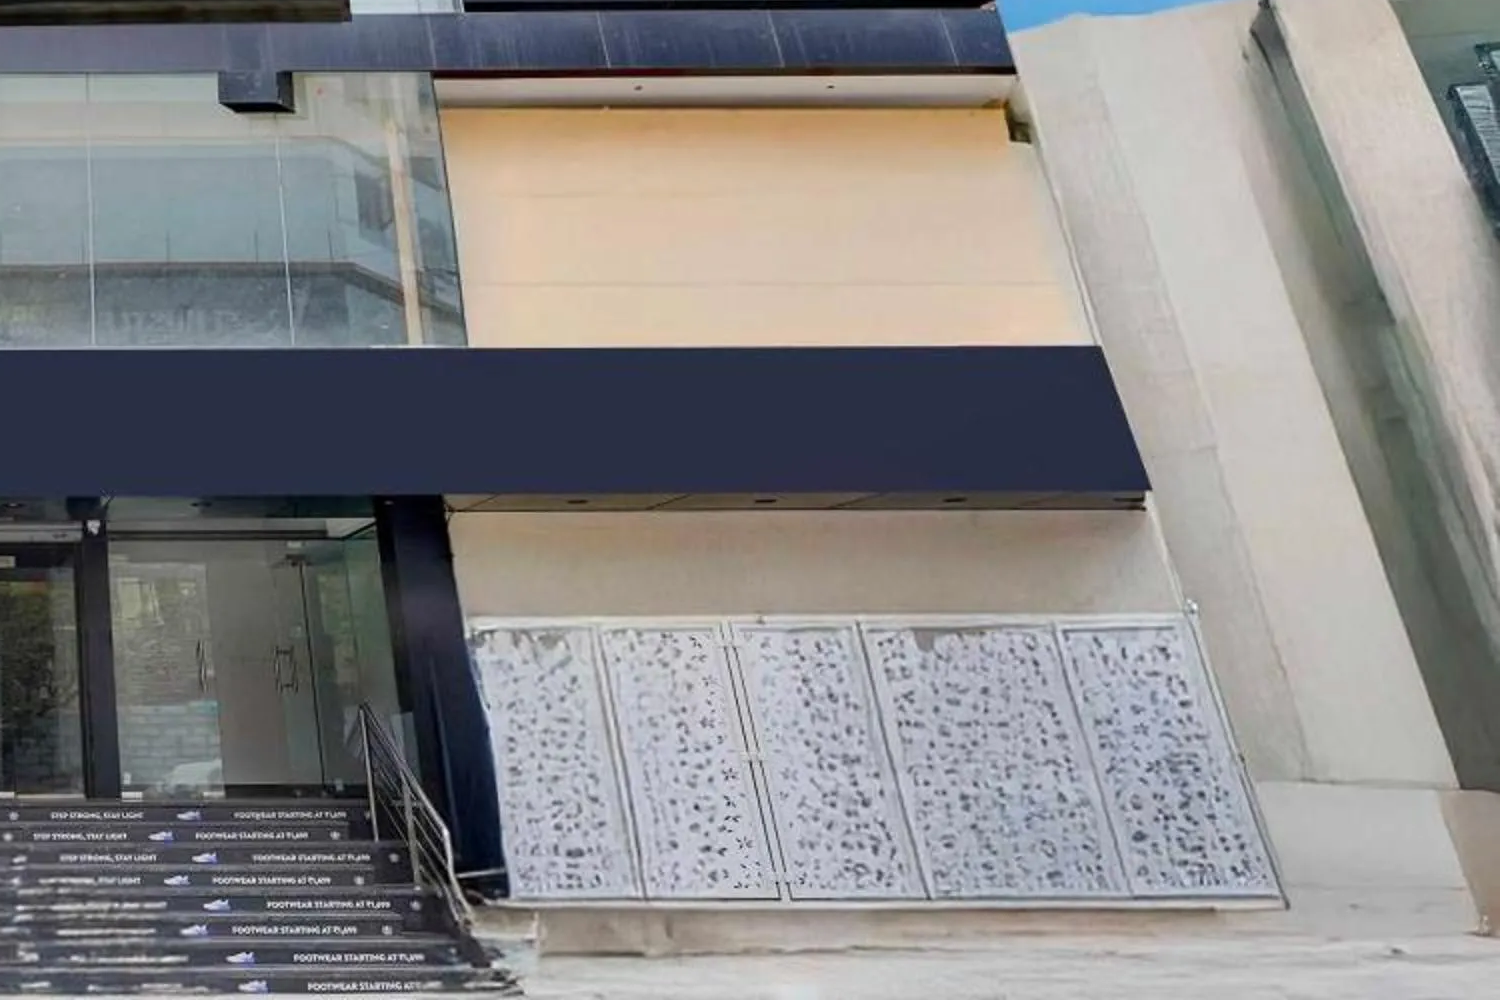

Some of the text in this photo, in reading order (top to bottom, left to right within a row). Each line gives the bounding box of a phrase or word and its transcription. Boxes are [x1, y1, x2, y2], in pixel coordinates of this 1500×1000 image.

[234, 811, 276, 820] FOOTWEAR
[278, 811, 313, 820] STARTING
[195, 832, 237, 841] FOOTWEAR
[239, 832, 274, 841] STARTING
[252, 853, 296, 862] FOOTWEAR
[298, 853, 334, 862] STARTING
[212, 876, 256, 885] FOOTWEAR
[258, 876, 296, 885] STARTING
[266, 900, 312, 910] FOOTWEAR
[314, 900, 353, 910] STARTING
[232, 925, 278, 935] FOOTWEAR
[281, 925, 319, 935] STARTING
[293, 953, 342, 963] FOOTWEAR
[344, 953, 386, 963] STARTING
[307, 981, 358, 992] FOOTWEAR
[359, 981, 402, 992] STARTING
